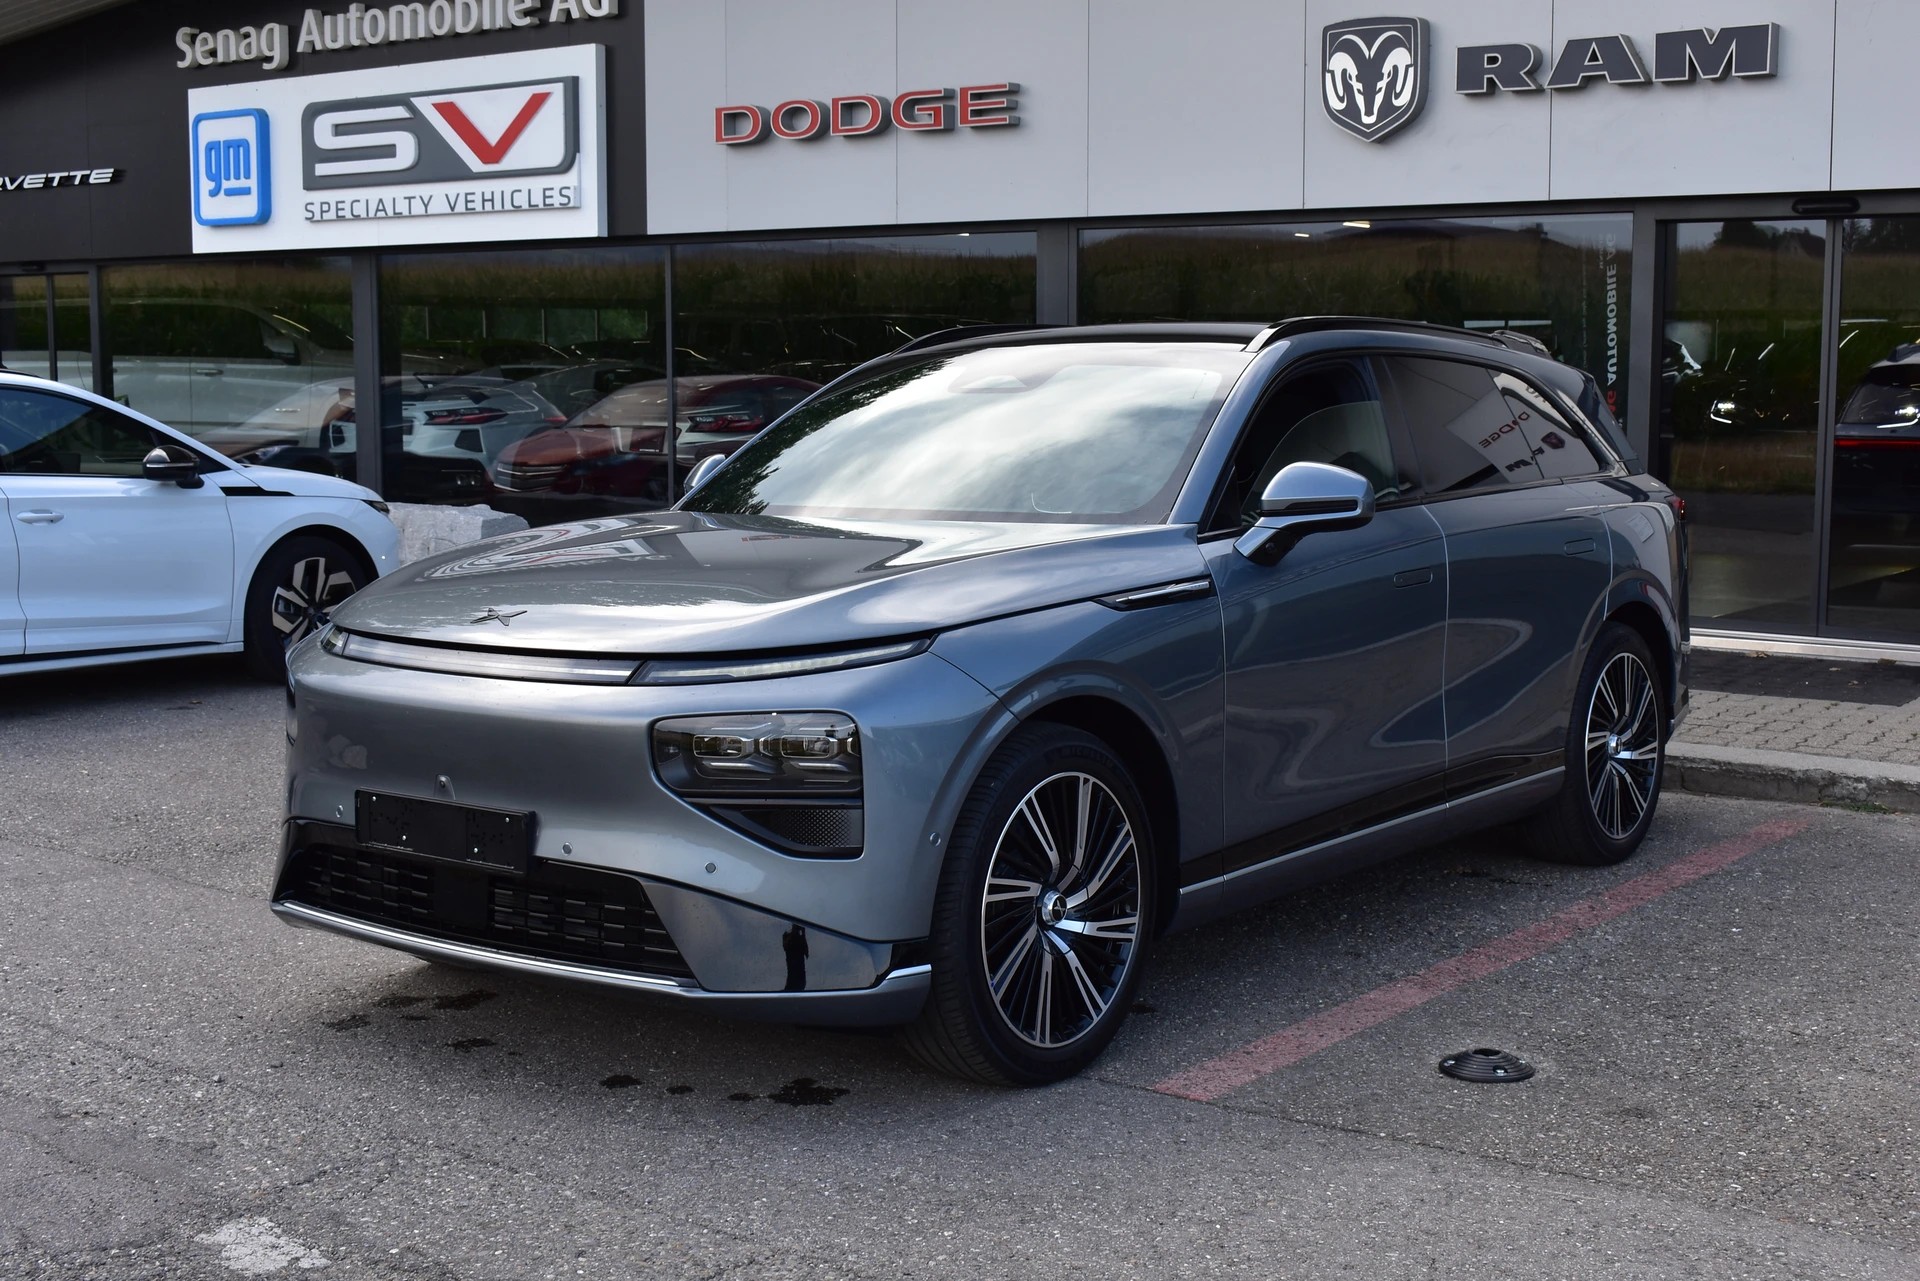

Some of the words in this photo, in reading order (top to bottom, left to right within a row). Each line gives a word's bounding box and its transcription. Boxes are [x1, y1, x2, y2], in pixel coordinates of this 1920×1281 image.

[175, 22, 288, 70] Senag
[296, 0, 539, 53] Automobile
[1455, 22, 1779, 94] RAM
[312, 91, 555, 178] SV
[714, 82, 1018, 145] DODGE
[0, 168, 115, 191] VETTE
[204, 138, 252, 198] gm
[304, 194, 434, 221] SPECIALTY
[444, 185, 572, 213] VEHICLES
